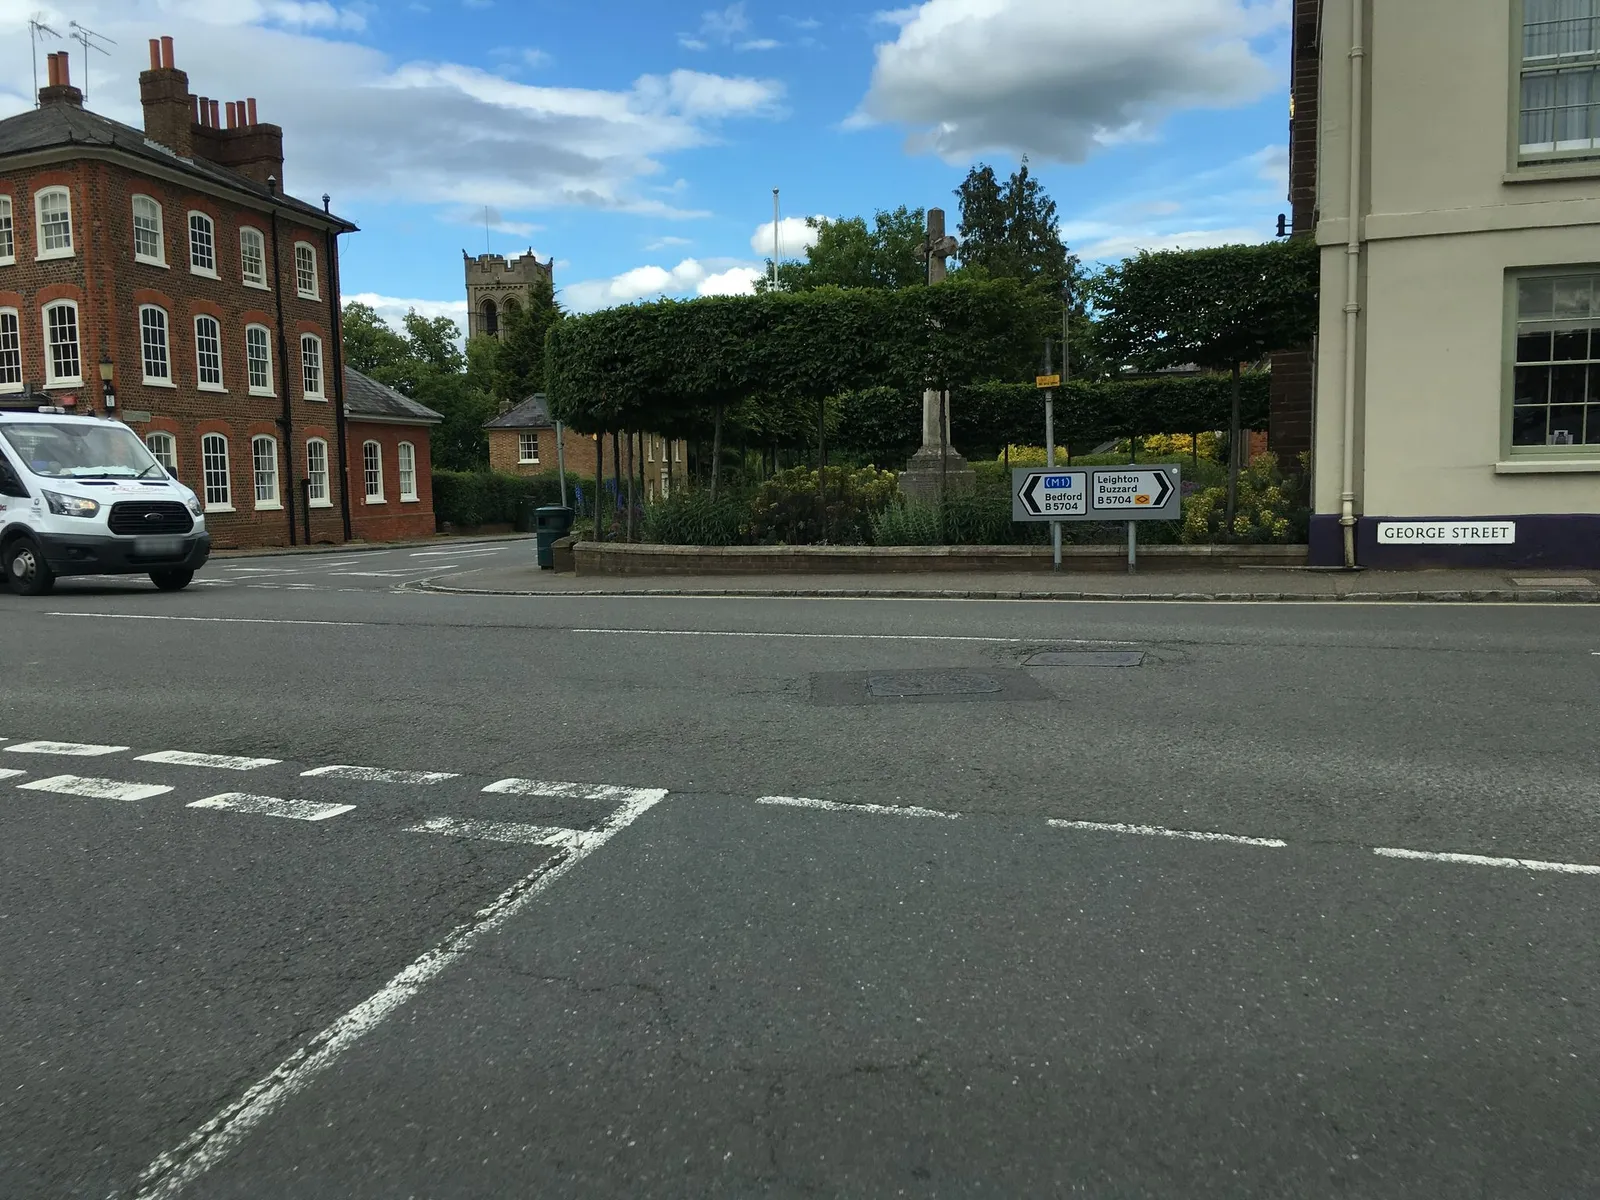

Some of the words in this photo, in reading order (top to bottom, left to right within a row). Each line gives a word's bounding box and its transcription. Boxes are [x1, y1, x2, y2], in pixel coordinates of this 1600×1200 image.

[1045, 477, 1070, 488] (M1)
[1097, 475, 1139, 484] Leighton
[1099, 484, 1138, 493] Buzzard
[1045, 493, 1082, 501] Bedford
[1384, 527, 1445, 538] GEORGE
[1452, 527, 1509, 538] STREET
